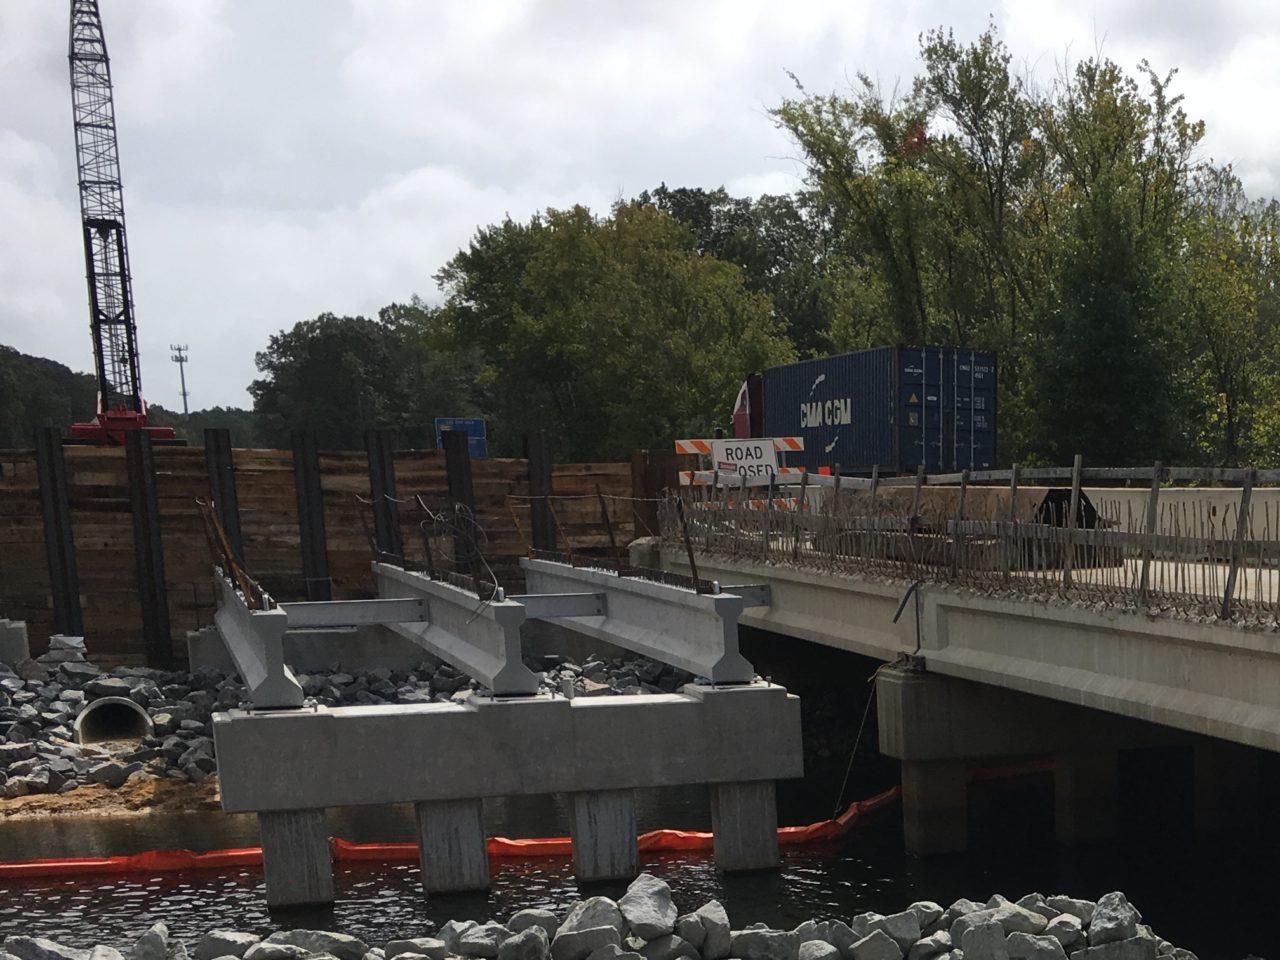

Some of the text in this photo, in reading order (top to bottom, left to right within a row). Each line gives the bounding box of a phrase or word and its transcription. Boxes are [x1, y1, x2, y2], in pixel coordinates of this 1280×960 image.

[801, 398, 851, 428] CMA CGM
[725, 446, 763, 461] ROAD
[738, 464, 774, 477] OSED
